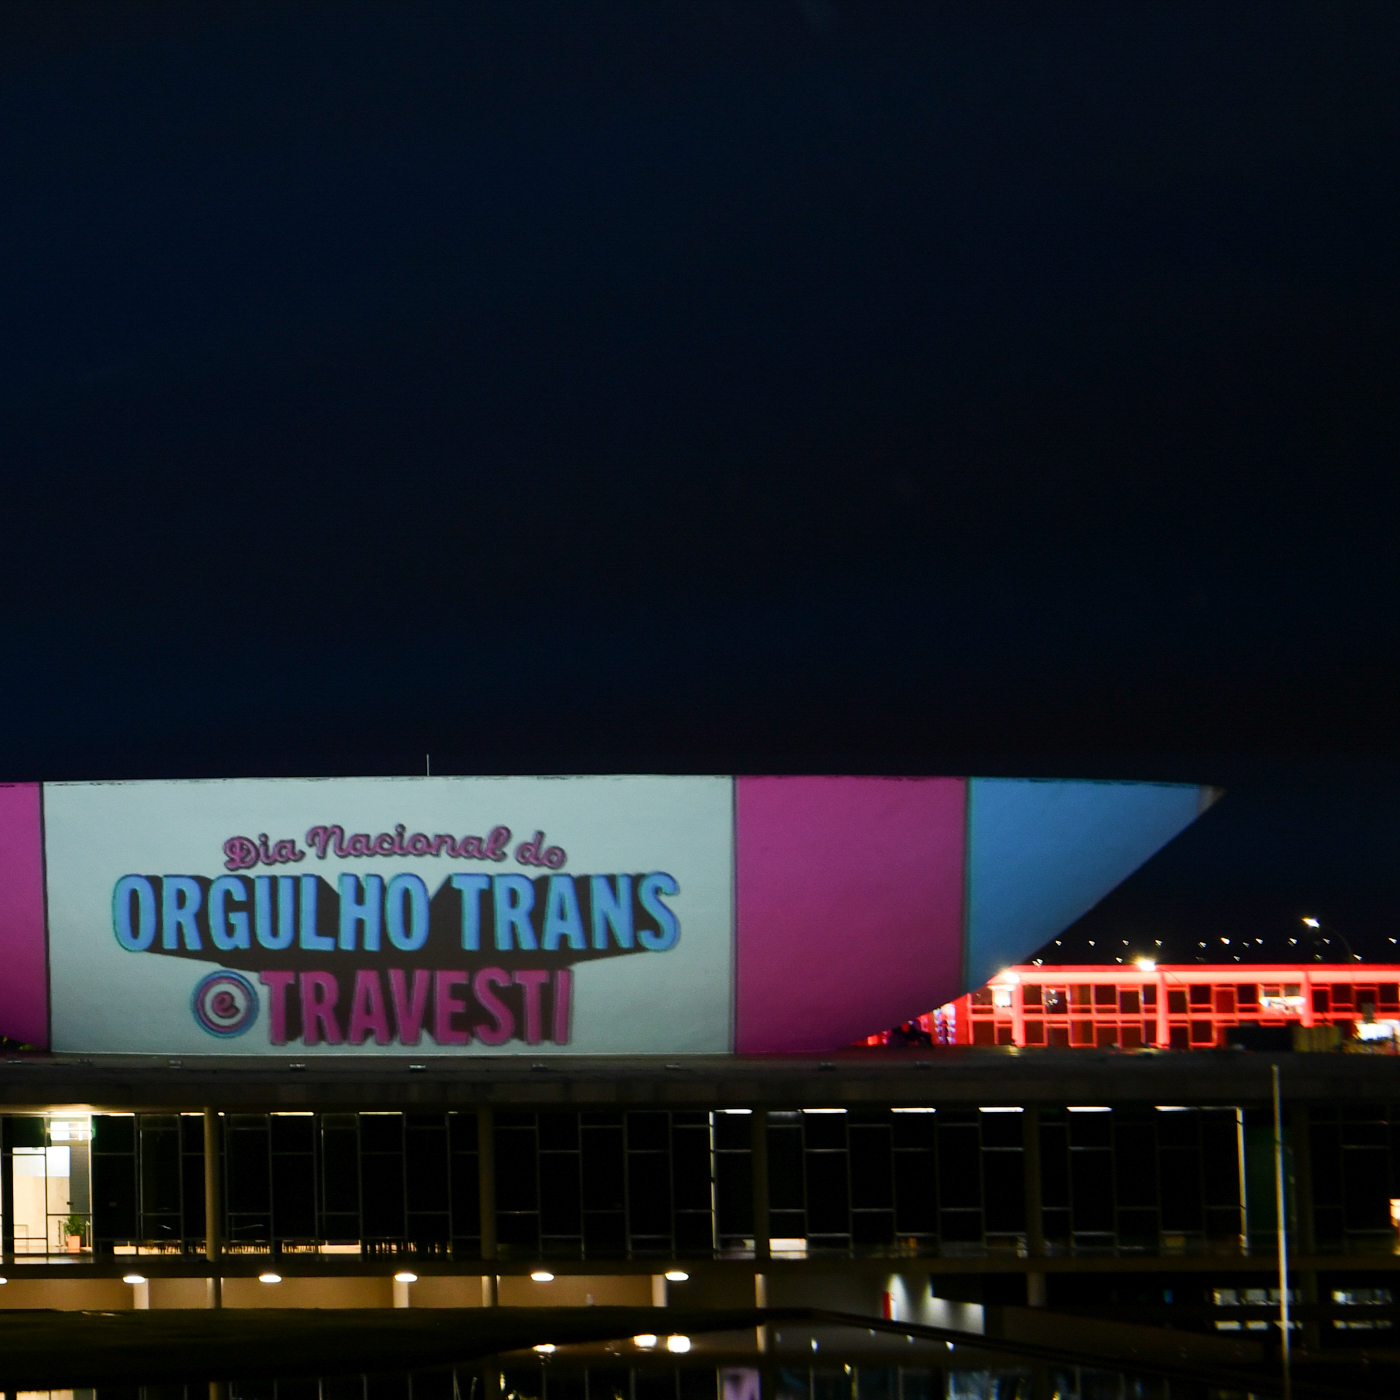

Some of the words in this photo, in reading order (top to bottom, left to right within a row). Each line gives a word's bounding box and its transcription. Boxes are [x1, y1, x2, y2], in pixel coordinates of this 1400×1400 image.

[223, 832, 306, 872] Dia
[306, 823, 512, 860] Nacional
[514, 830, 567, 869] do
[111, 873, 431, 953] ORGULHO
[450, 871, 681, 952] TRANS
[258, 966, 574, 1047] TRAVESTI
